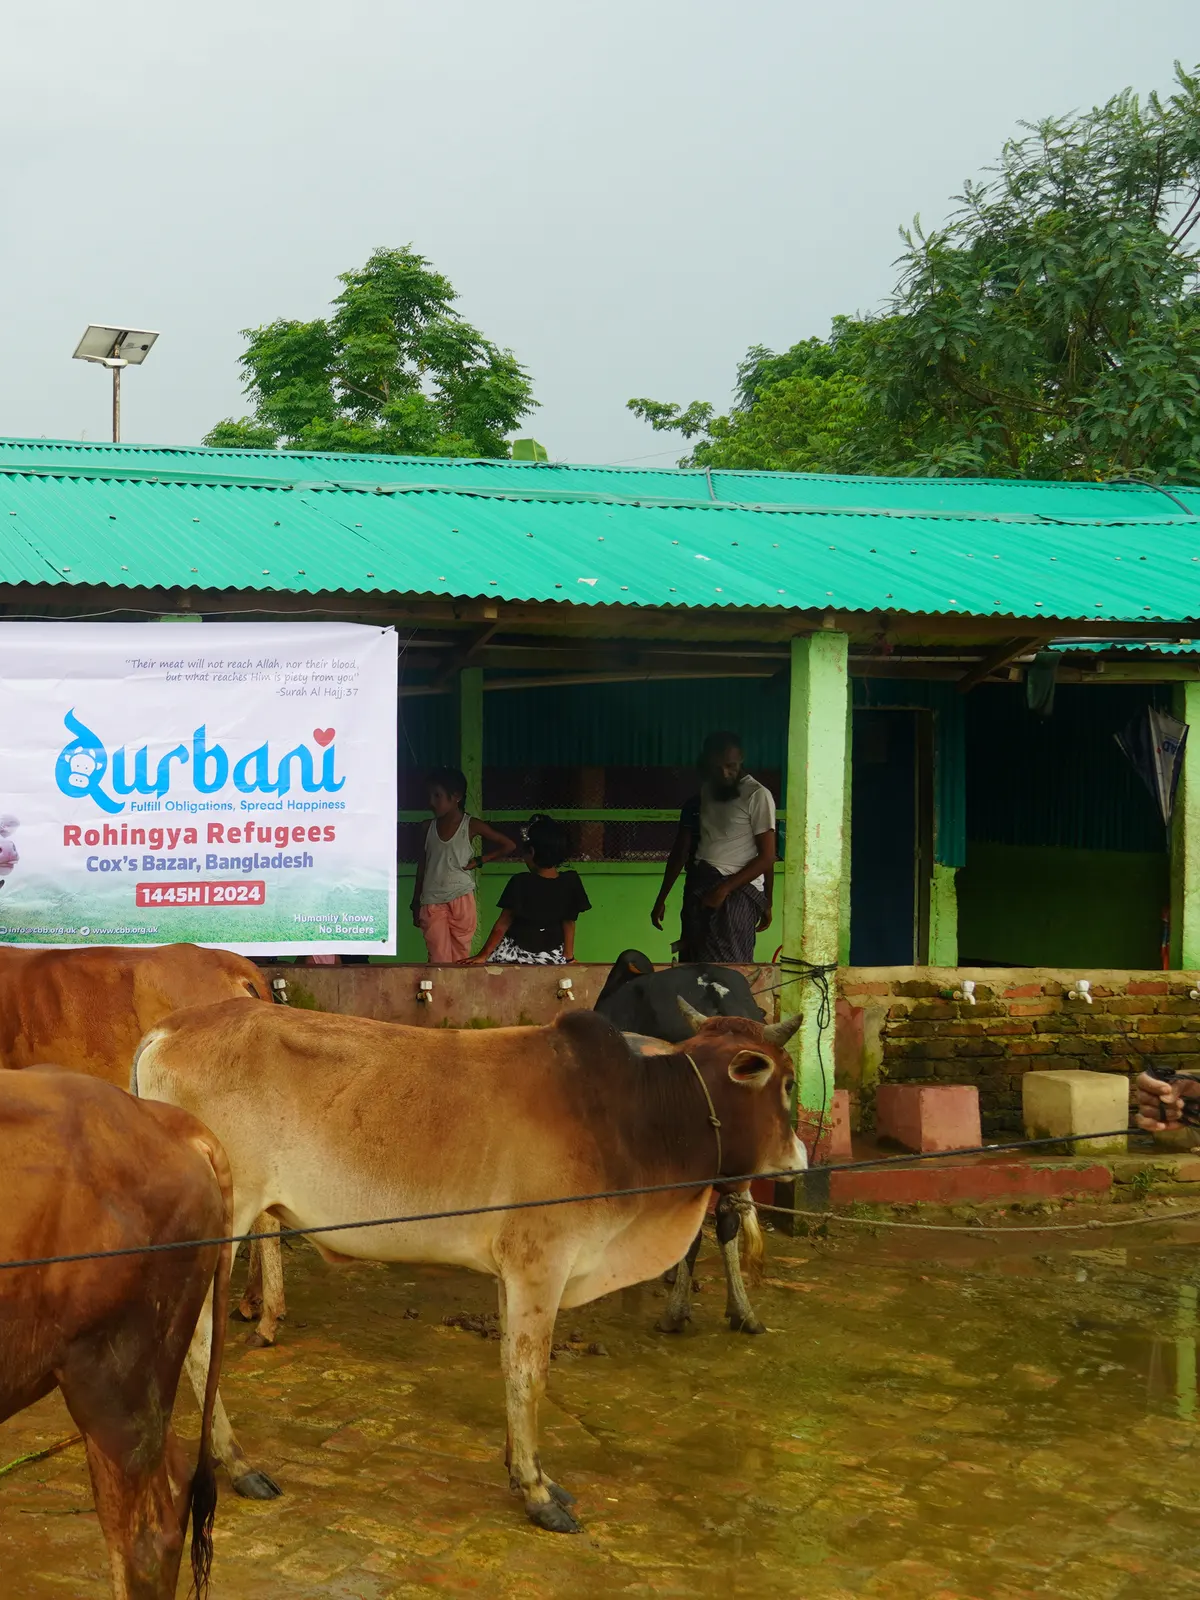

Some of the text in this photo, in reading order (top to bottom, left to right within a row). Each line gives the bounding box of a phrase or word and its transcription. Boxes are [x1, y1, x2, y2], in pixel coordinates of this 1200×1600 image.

[159, 659, 184, 669] meat
[188, 658, 205, 669] will
[207, 659, 224, 669] not
[227, 658, 253, 669] reach
[255, 658, 283, 670] Allah,
[286, 661, 303, 669] nor
[305, 658, 328, 669] their
[331, 658, 360, 670] blood,
[165, 671, 182, 682] but
[185, 671, 209, 682] what
[212, 671, 248, 682] reaches
[250, 671, 271, 681] Him
[274, 671, 281, 681] is
[284, 671, 308, 685] piety
[311, 671, 335, 682] from
[310, 687, 321, 697] Al
[324, 687, 359, 700] Hajj:37
[54, 706, 347, 815] Qurbani
[130, 799, 346, 814] Fulfill Obligations, Spread Happiness
[63, 820, 336, 850] Rohingya Refugees
[142, 854, 202, 874] Bazar,
[205, 851, 314, 874] Bangladesh
[142, 886, 200, 903] 1445H
[213, 886, 261, 902] 2024
[294, 913, 374, 924] Humanity Knows
[92, 926, 159, 936] www.cbb.org.uk
[319, 925, 374, 934] No Borders
